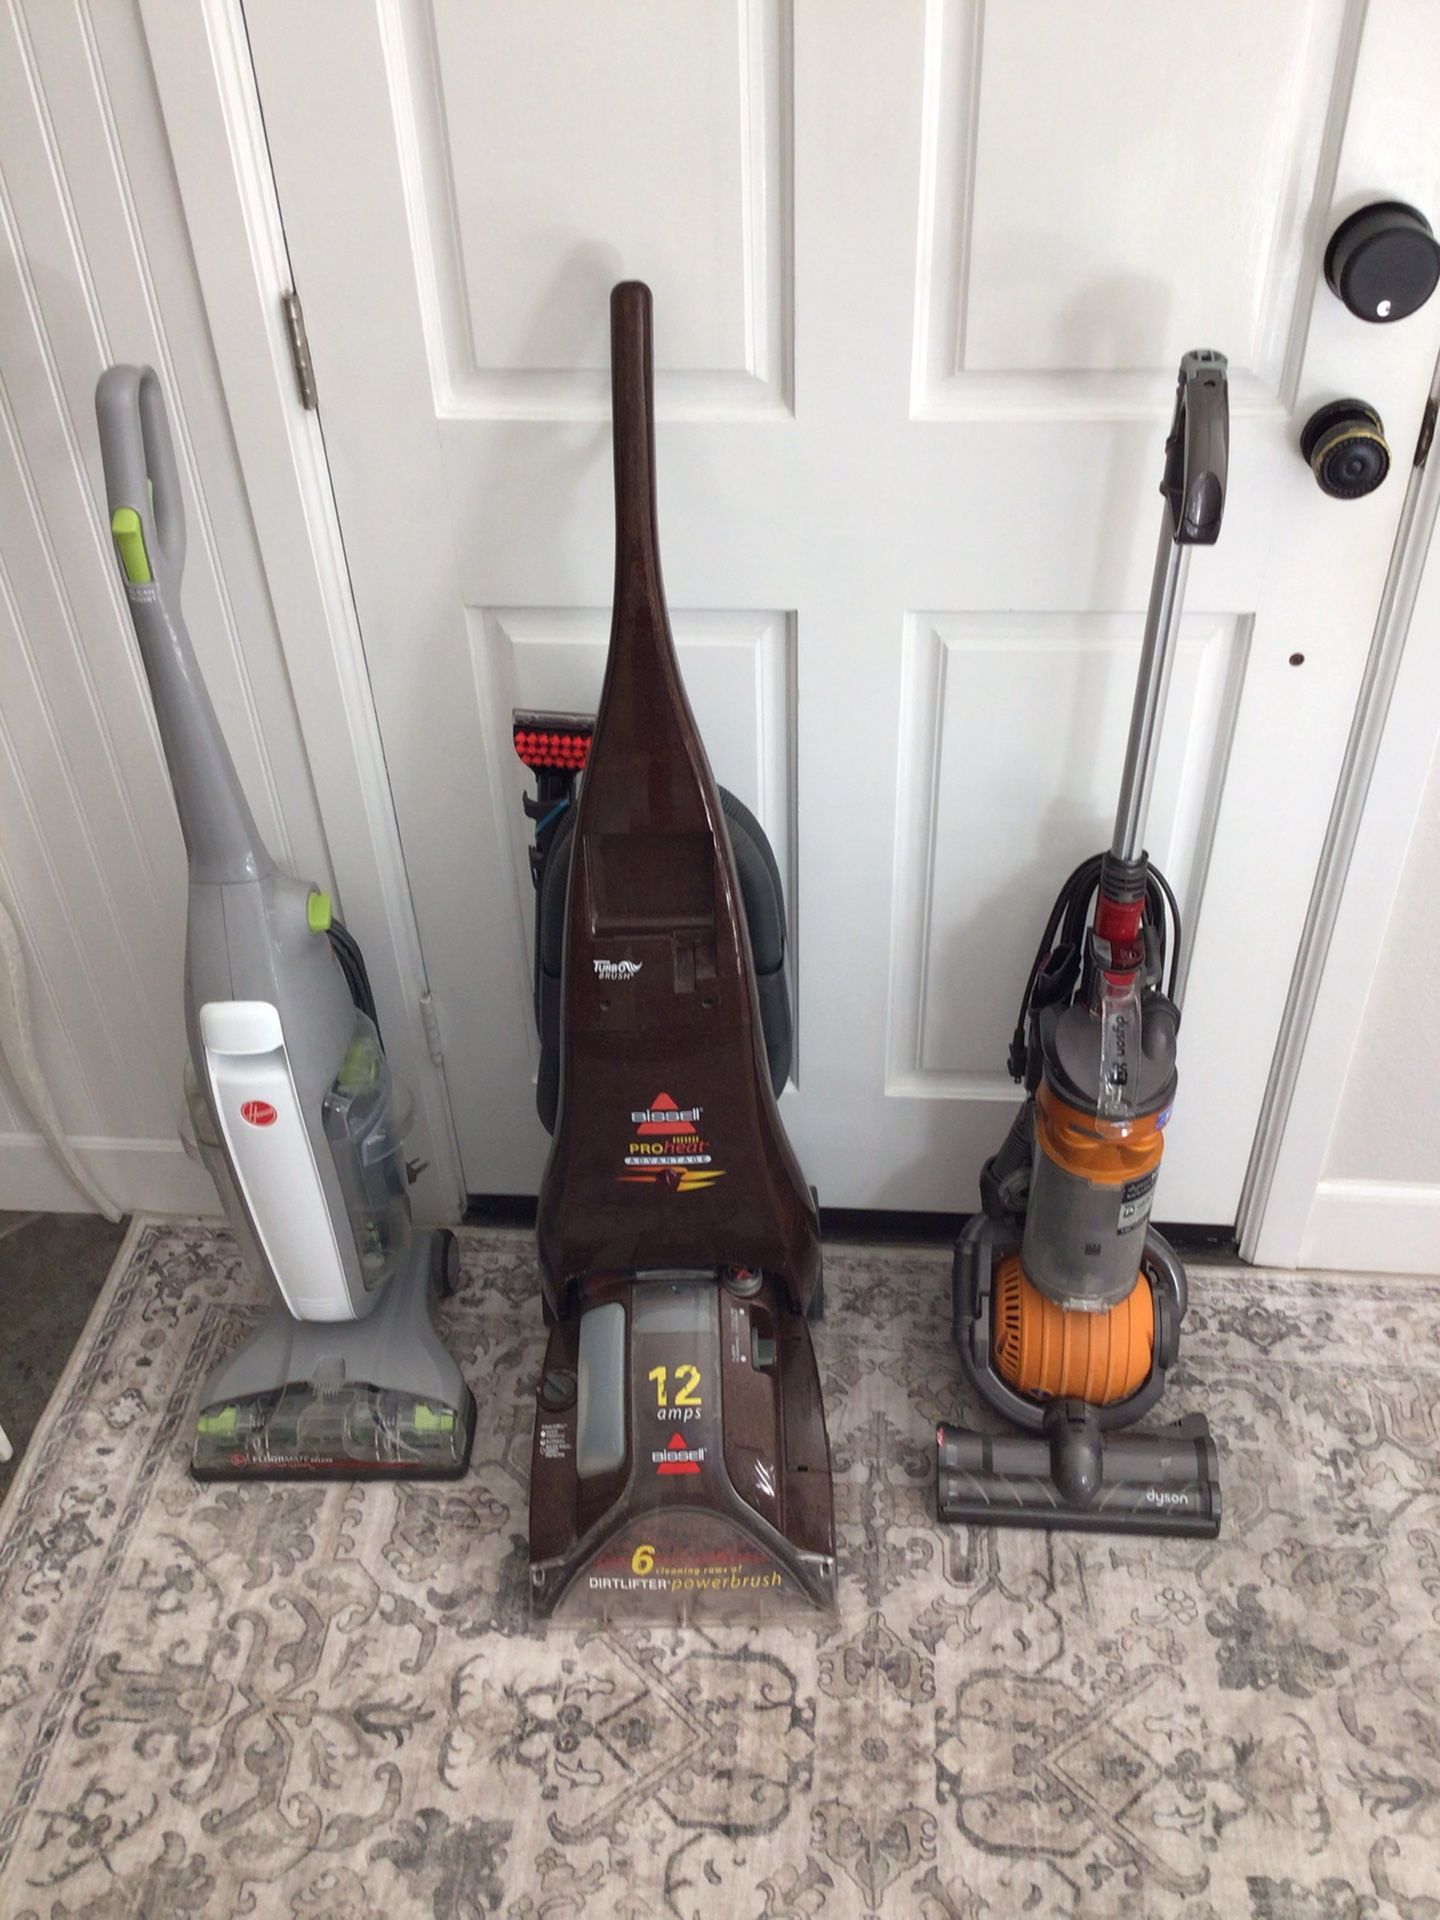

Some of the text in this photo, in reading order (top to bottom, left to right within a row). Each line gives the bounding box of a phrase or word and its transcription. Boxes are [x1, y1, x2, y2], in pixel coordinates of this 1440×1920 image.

[1113, 1016, 1128, 1056] dyson
[648, 1365, 703, 1406] 12
[657, 1407, 702, 1423] amps
[1146, 1488, 1189, 1507] dyson
[631, 1545, 655, 1576] 6
[656, 1567, 700, 1576] cleaning
[703, 1566, 728, 1575] rows
[671, 1571, 782, 1593] powerbrush
